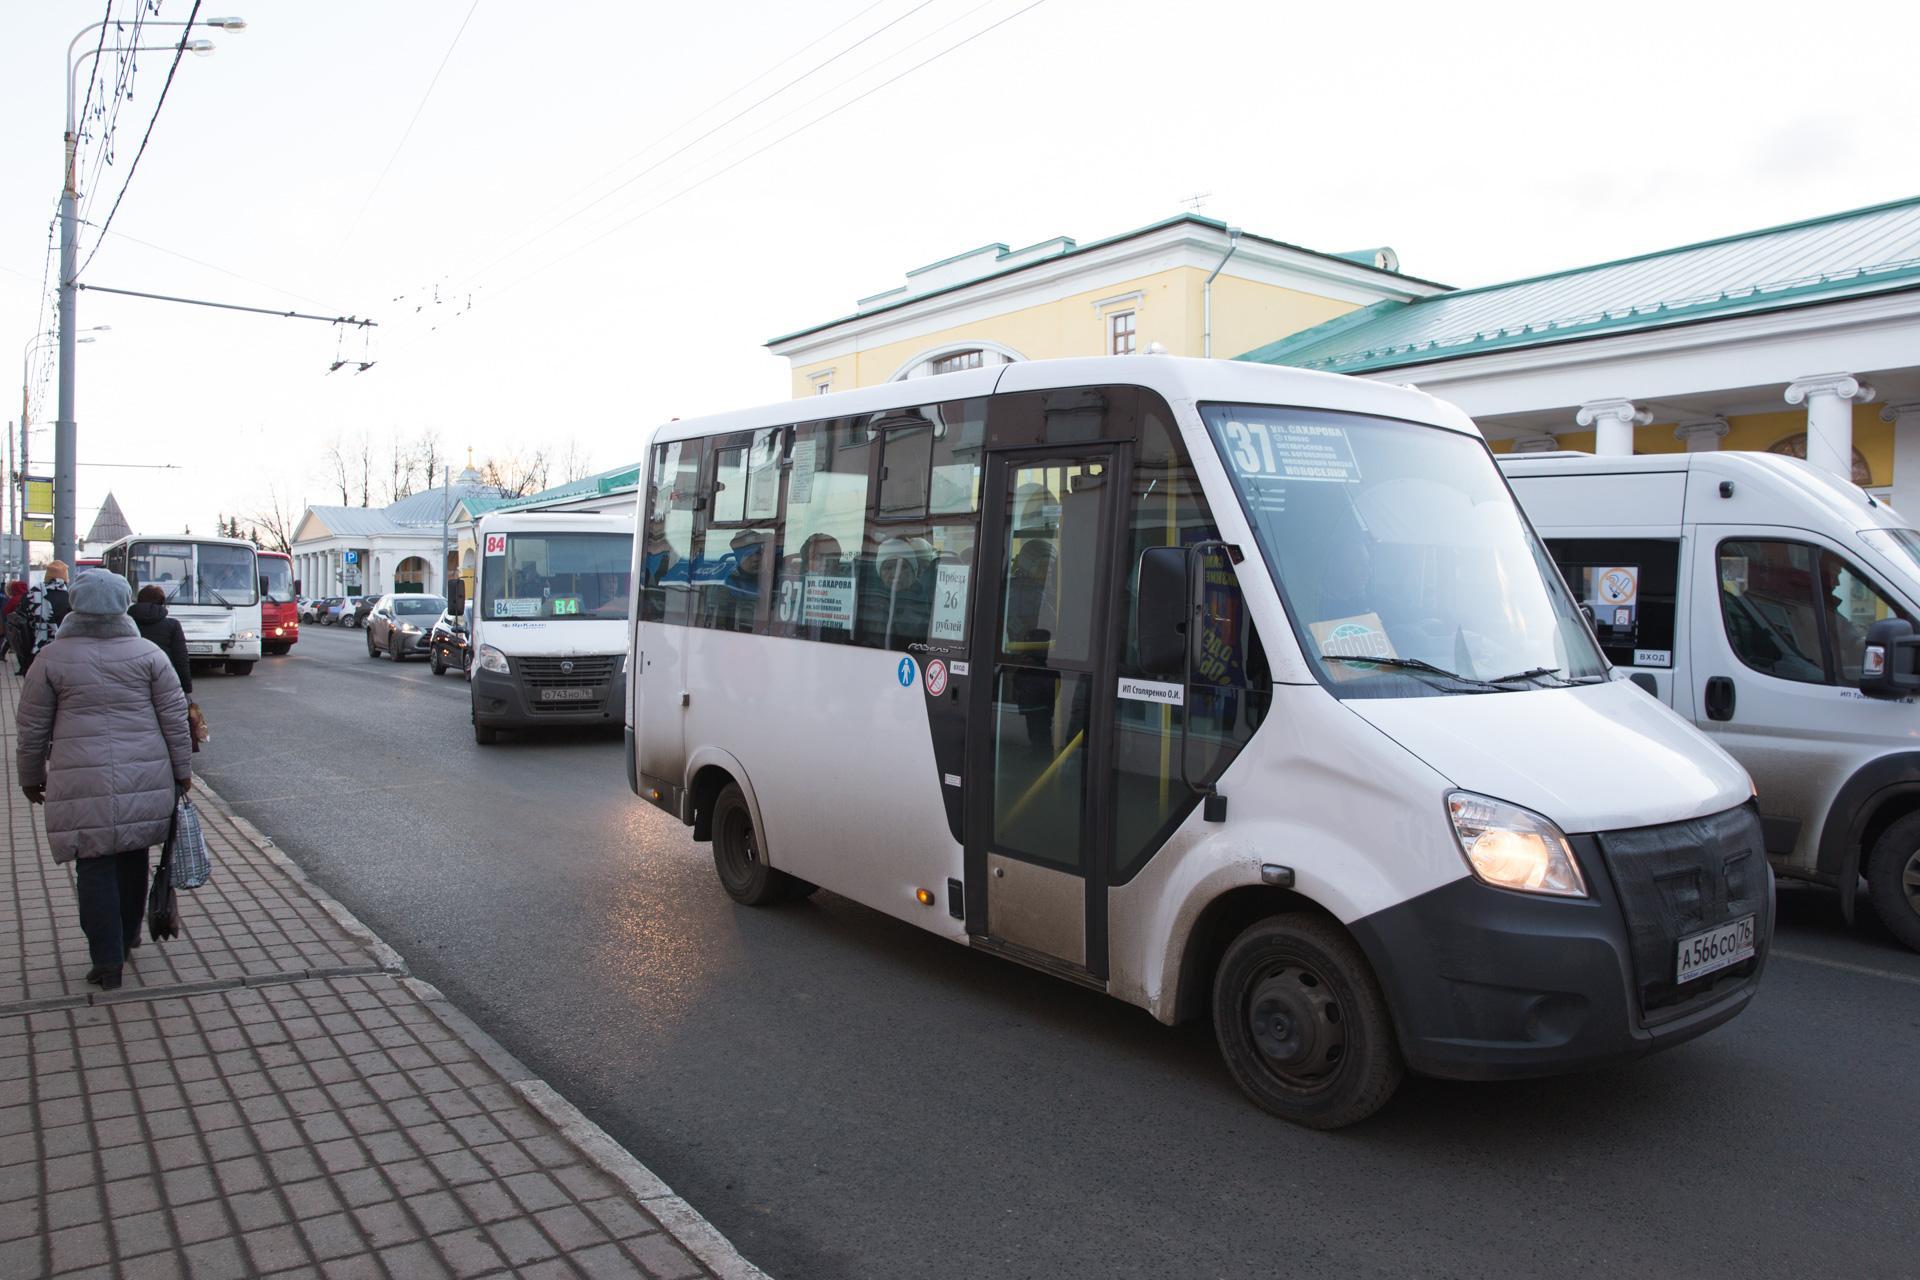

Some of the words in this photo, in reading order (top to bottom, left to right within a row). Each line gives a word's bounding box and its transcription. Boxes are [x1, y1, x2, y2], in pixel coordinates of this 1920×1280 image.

[1288, 425, 1343, 437] САХАРОВА
[1226, 421, 1276, 473] 37
[487, 537, 505, 553] 84
[818, 580, 852, 589] САХАРОВА
[555, 599, 577, 615] 84
[780, 580, 803, 621] 37
[943, 590, 958, 610] 26
[496, 603, 508, 614] 84
[935, 619, 962, 633] рублей
[1640, 653, 1665, 662] ВХОД
[1122, 684, 1132, 693] ИП
[1682, 933, 1736, 971] А566СО
[1739, 921, 1751, 942] 76
